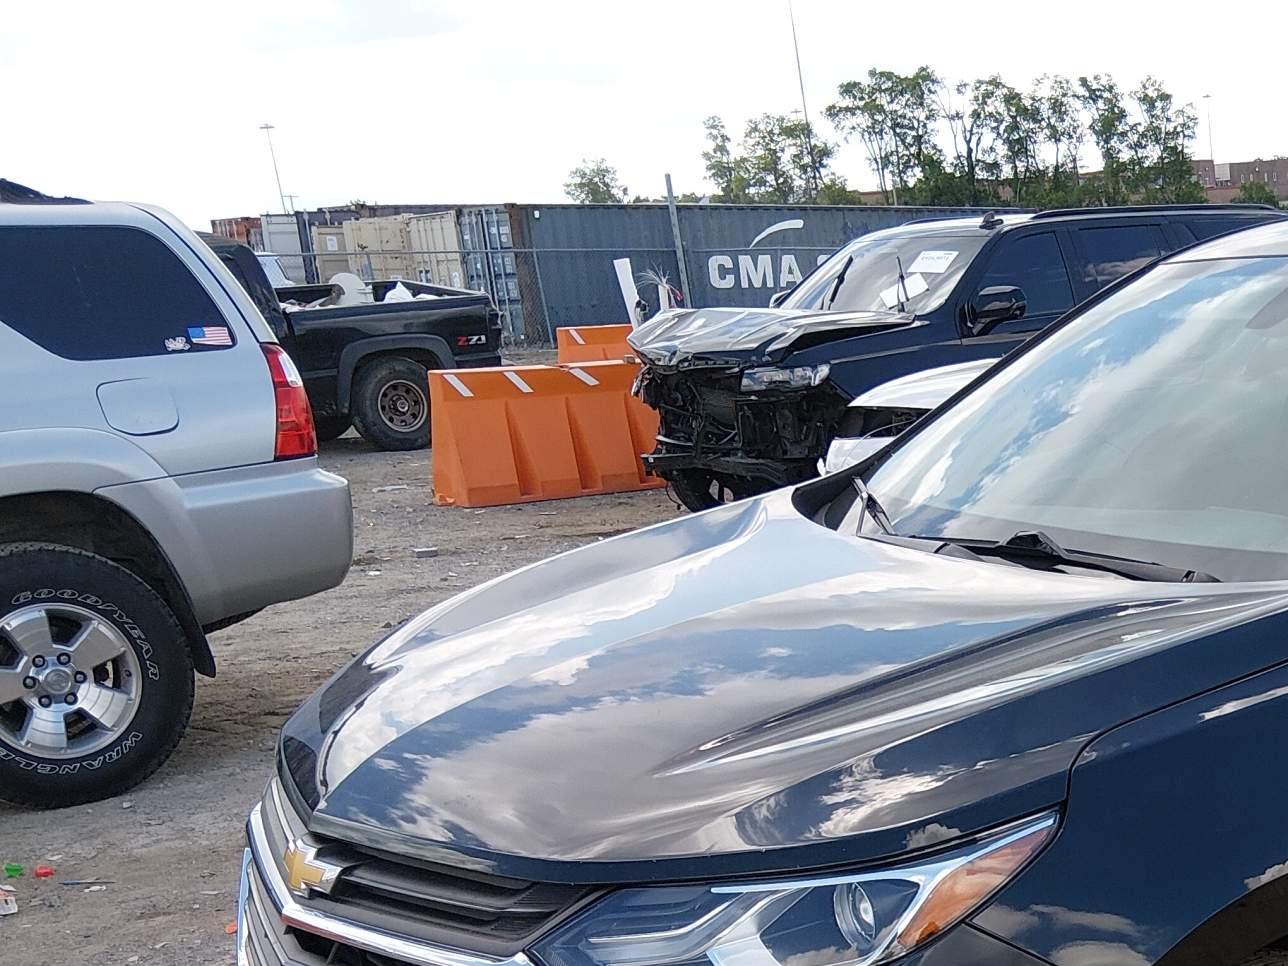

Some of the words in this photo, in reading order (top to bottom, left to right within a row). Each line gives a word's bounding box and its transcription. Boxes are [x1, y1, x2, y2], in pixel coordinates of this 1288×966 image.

[708, 254, 804, 289] CMA
[456, 335, 486, 345] Z71
[11, 588, 160, 680] GOODYEAR
